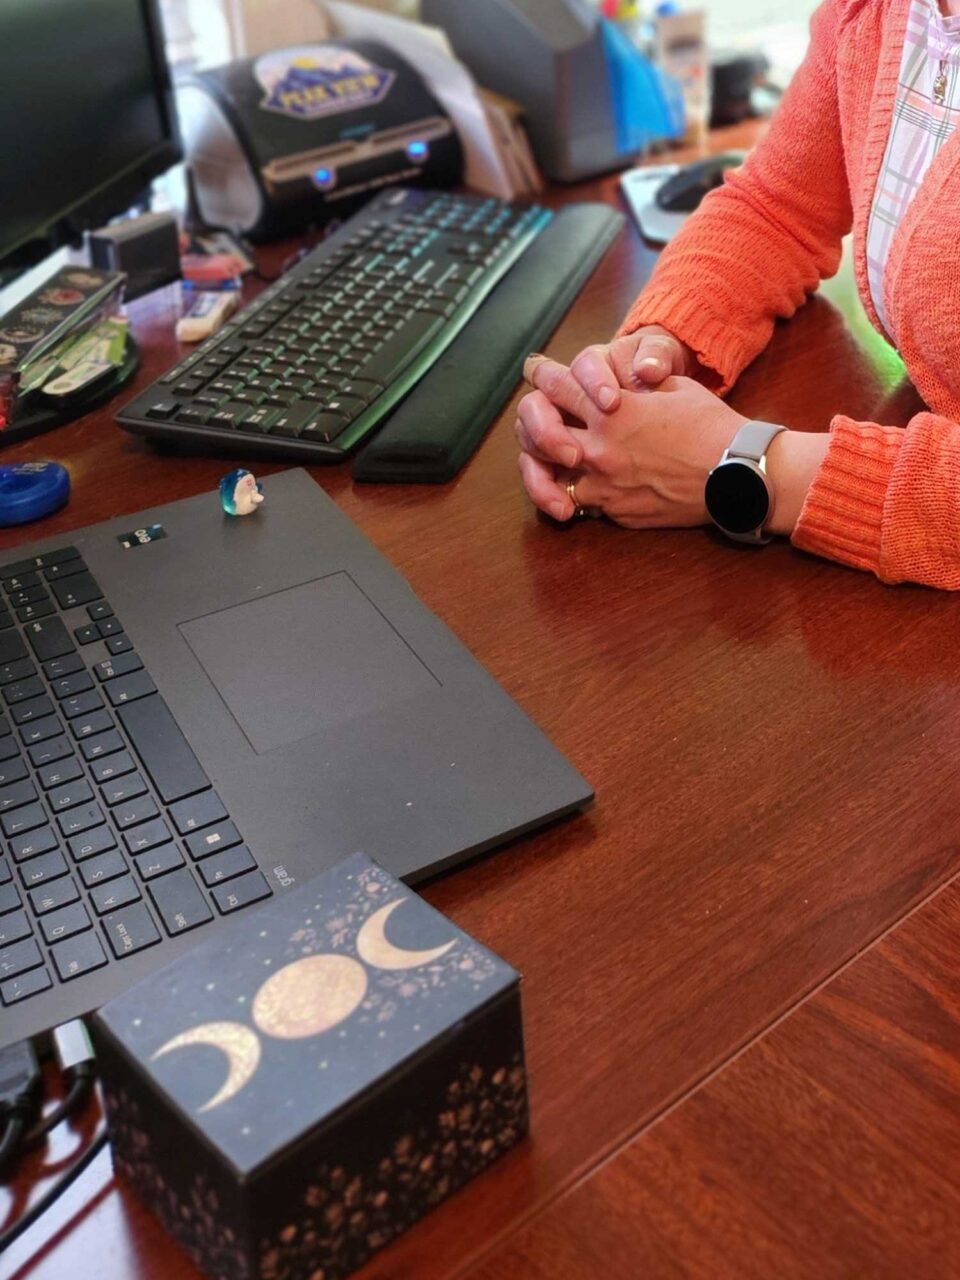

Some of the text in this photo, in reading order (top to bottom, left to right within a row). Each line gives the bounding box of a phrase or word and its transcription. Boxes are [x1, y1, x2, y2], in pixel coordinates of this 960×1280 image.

[50, 774, 61, 782] H
[59, 797, 71, 805] G
[124, 814, 136, 822] C
[136, 839, 148, 847] X
[22, 846, 33, 854] R
[81, 846, 93, 854] D
[31, 872, 43, 880] E
[92, 871, 104, 879] S
[272, 864, 296, 887] gram
[42, 897, 54, 908] W
[104, 896, 117, 905] A
[174, 913, 187, 928] Shift
[52, 925, 65, 936] Q
